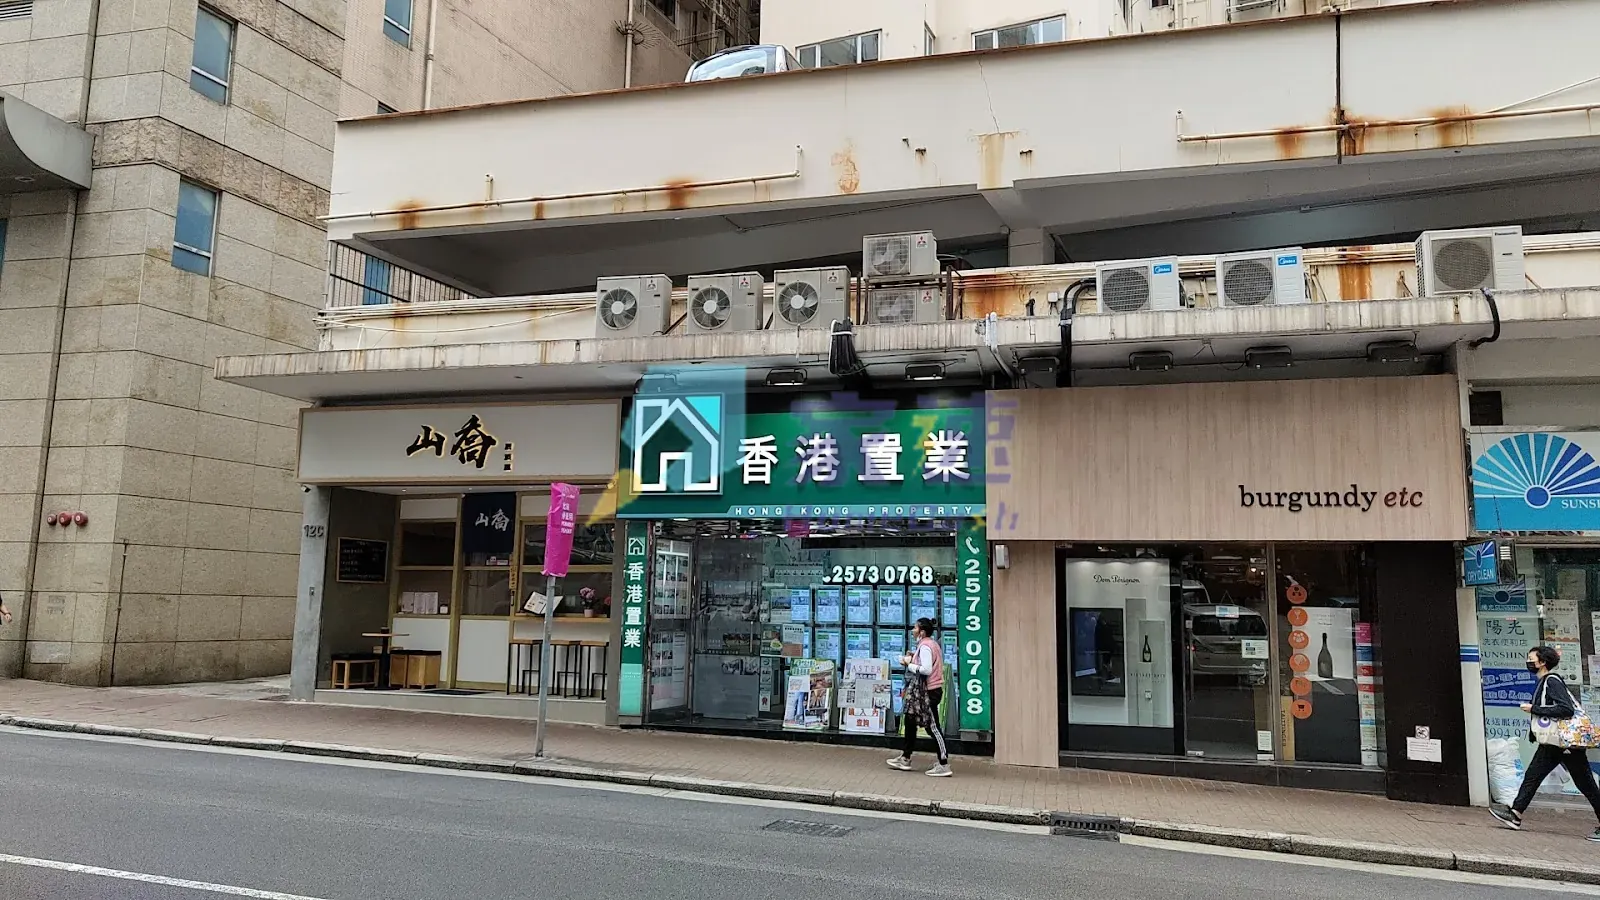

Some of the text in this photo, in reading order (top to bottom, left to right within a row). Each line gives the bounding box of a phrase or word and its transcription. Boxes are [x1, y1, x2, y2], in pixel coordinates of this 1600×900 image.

[735, 429, 971, 485] 香港置業
[1238, 484, 1423, 512] burgundy etc
[1561, 499, 1600, 509] SUNS
[735, 505, 973, 516] HONG KONG PROPERTY
[303, 524, 324, 538] 12C
[832, 565, 879, 583] 2573
[884, 565, 933, 584] 0768
[1093, 574, 1111, 583] Dom
[1477, 567, 1495, 580] CLEAN
[623, 561, 644, 648] 香港置業
[1486, 620, 1525, 636] 陽光
[964, 558, 983, 715] 2573 0768
[1480, 651, 1529, 659] SUNSHIN
